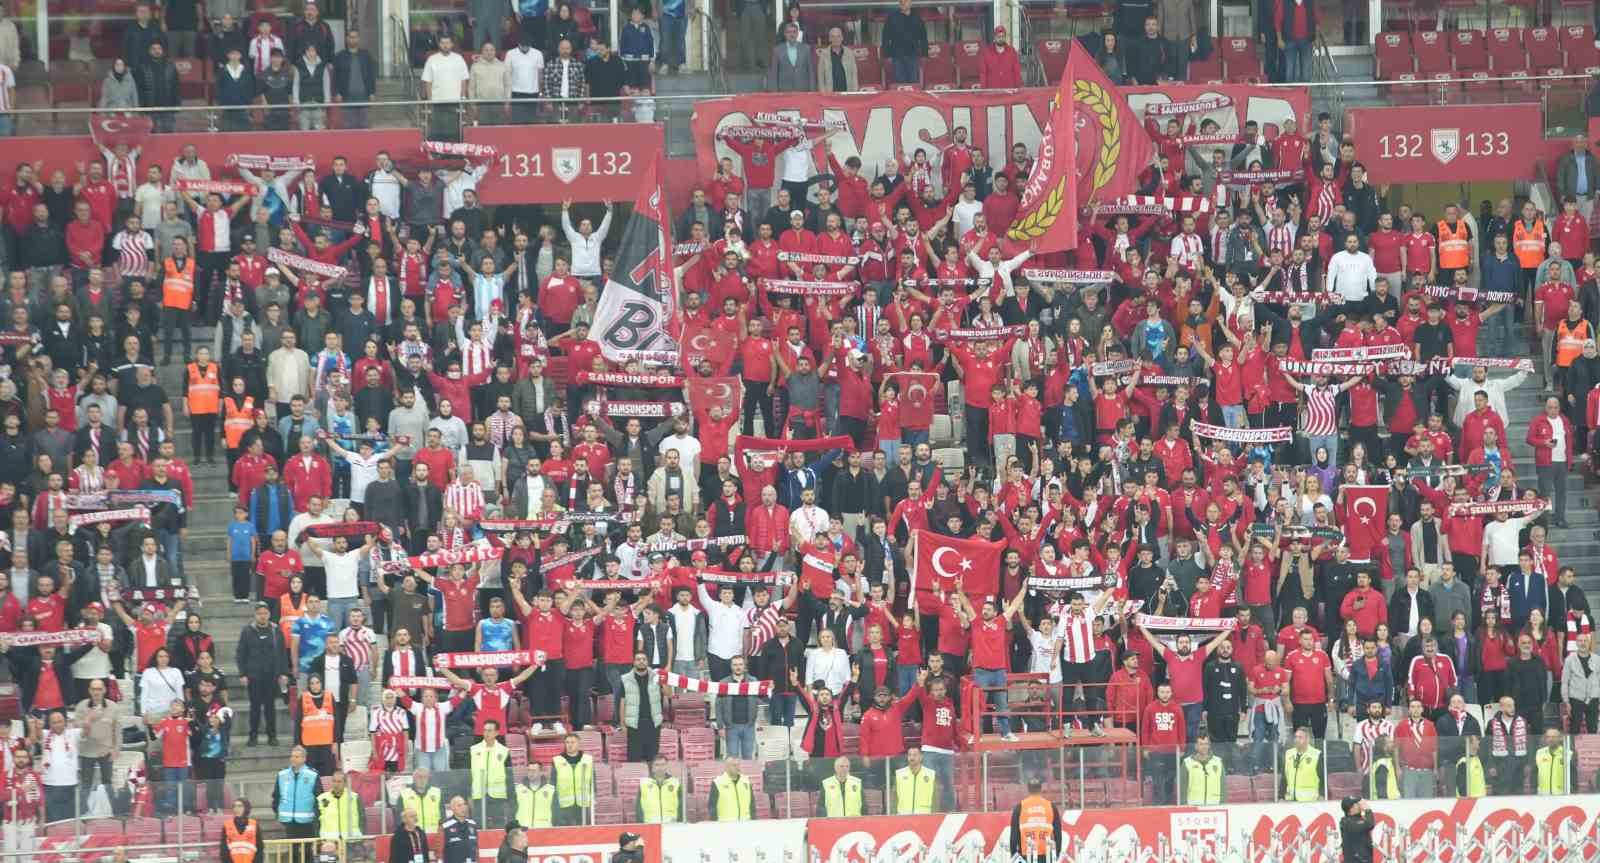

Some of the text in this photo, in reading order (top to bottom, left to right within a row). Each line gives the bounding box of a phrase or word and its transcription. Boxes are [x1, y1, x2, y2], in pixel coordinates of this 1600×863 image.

[1379, 132, 1509, 157] 132 133
[500, 152, 632, 177] 131 132
[588, 373, 675, 384] SAMSUNSPOR
[608, 403, 663, 415] SAMSUNSPOR
[1155, 712, 1175, 723] SBC
[1178, 813, 1221, 827] STORE
